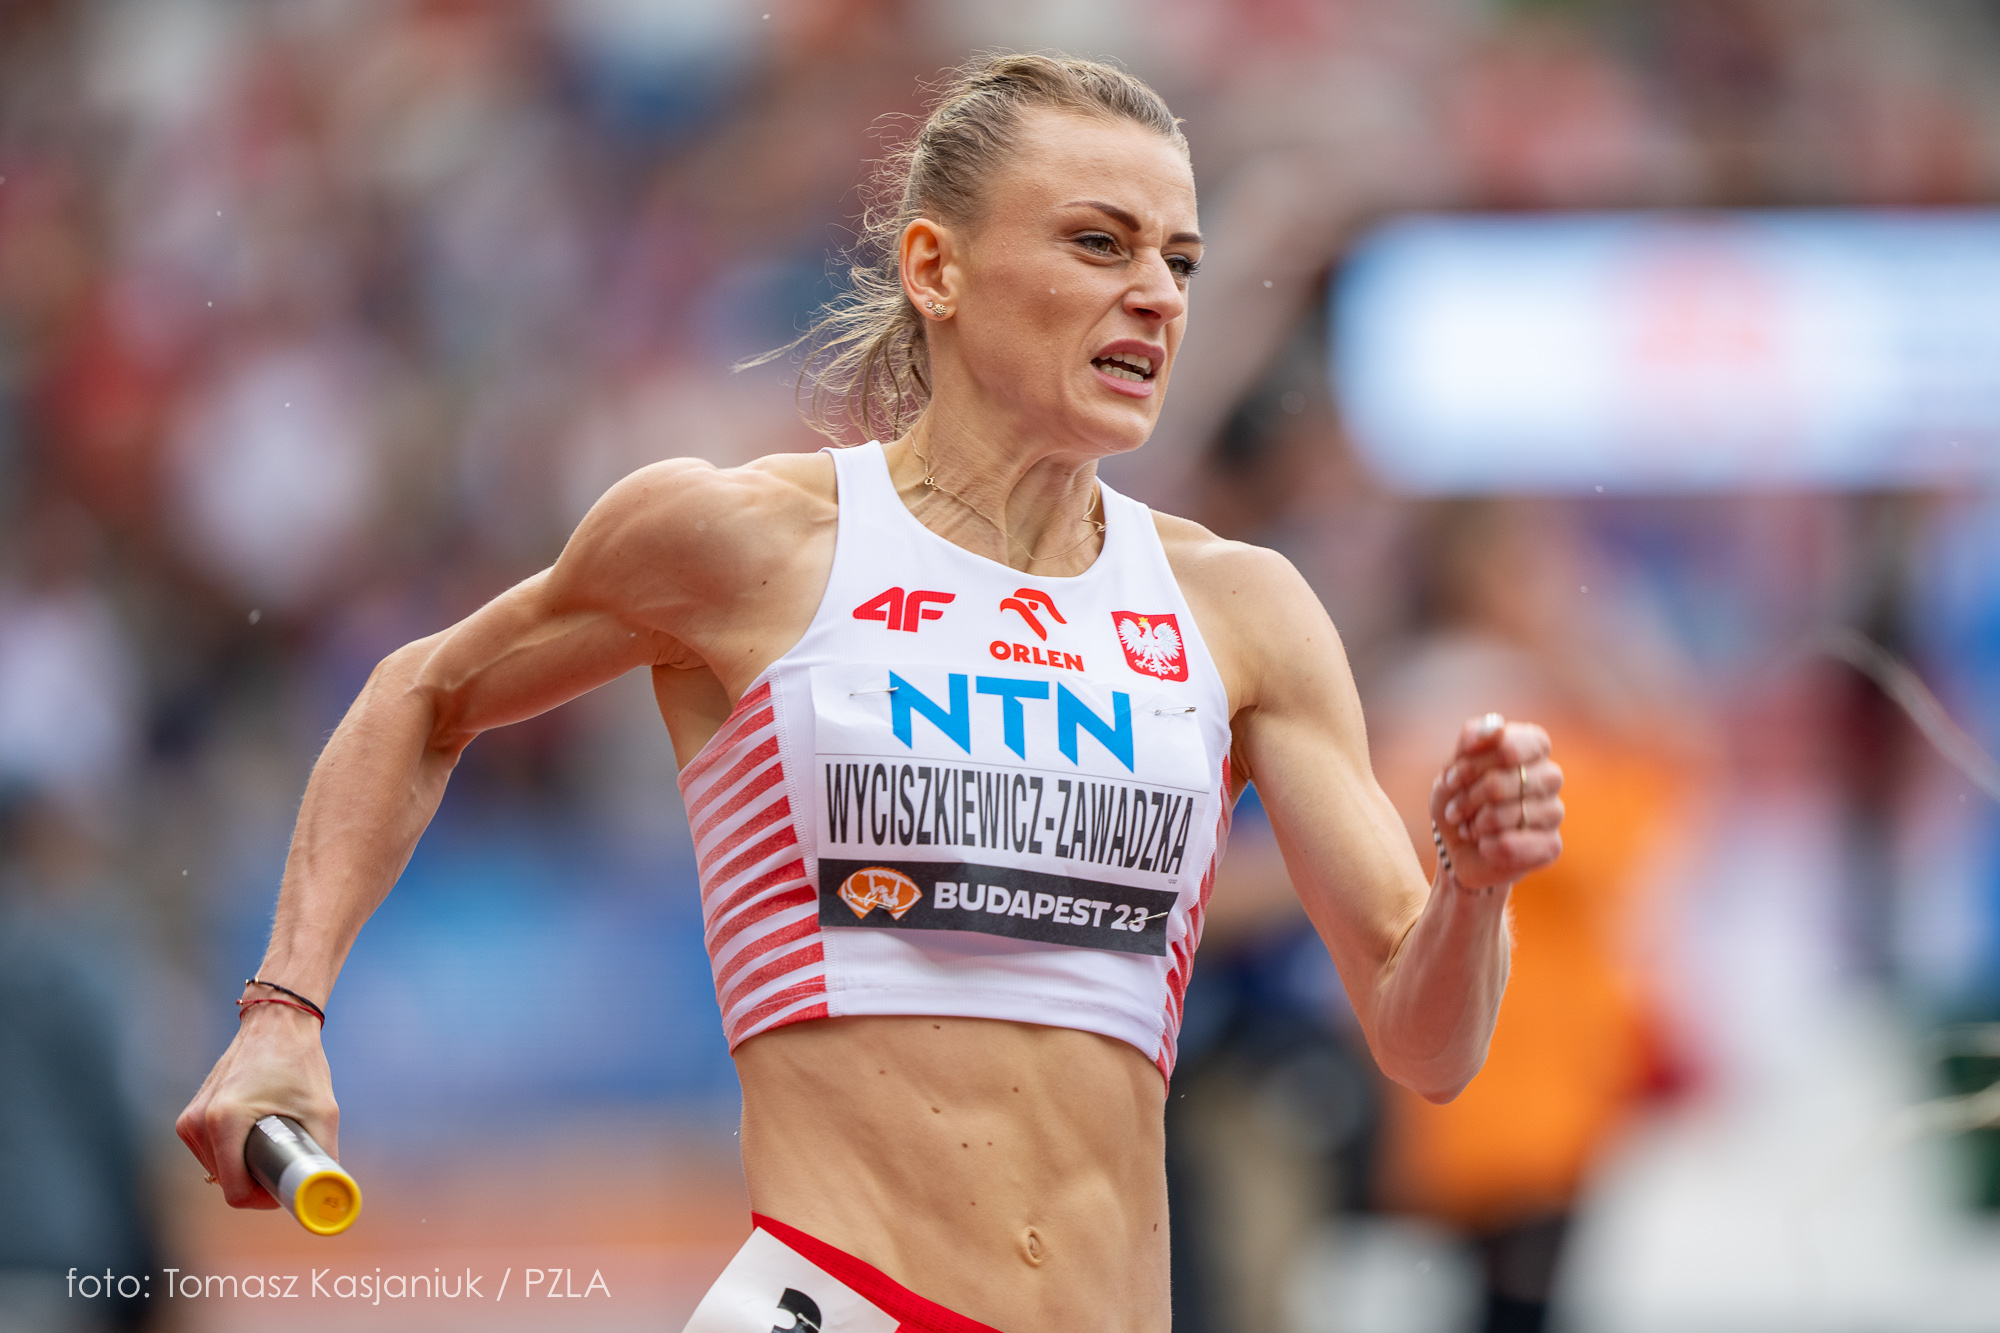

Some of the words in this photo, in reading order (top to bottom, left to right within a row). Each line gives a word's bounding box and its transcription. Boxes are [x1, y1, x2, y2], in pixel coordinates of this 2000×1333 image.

[852, 586, 956, 633] 4F
[989, 640, 1085, 672] ORLEN
[888, 670, 1135, 774] NTN
[826, 763, 1194, 876] WYCISZKIEWICZ-ZAWADZKA
[933, 881, 1111, 930] BUDAPEST
[1109, 904, 1150, 932] 23
